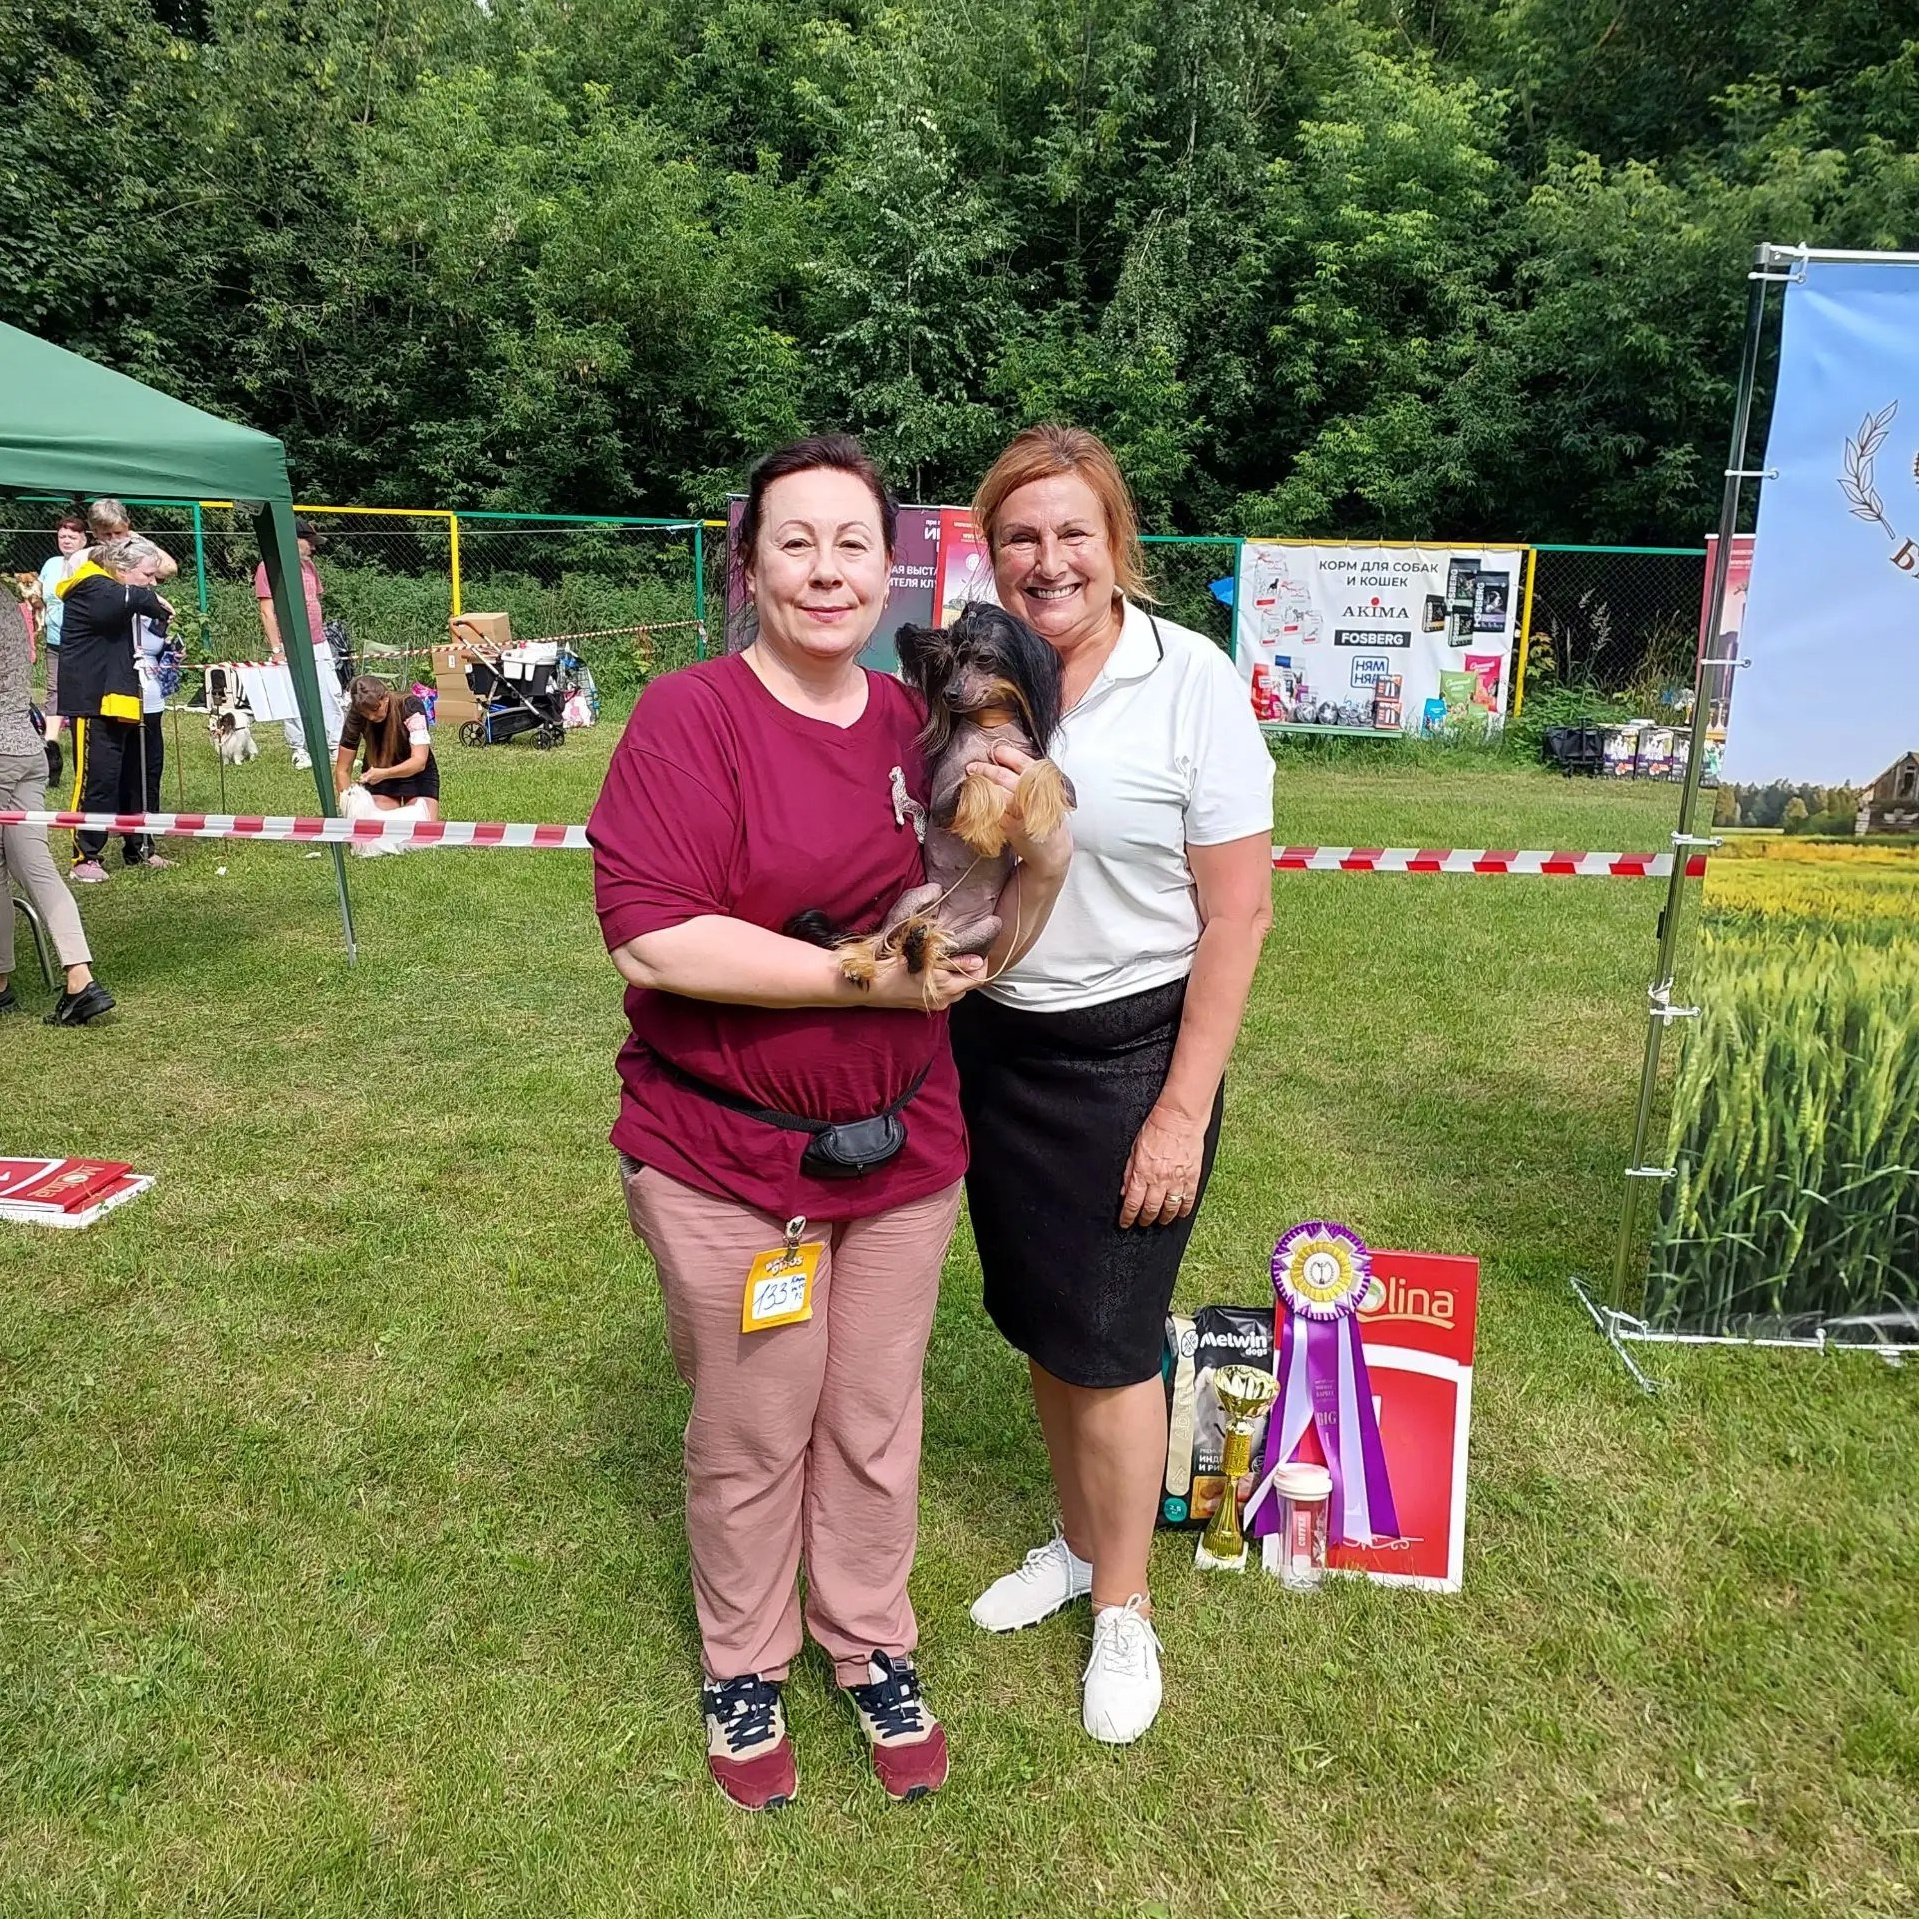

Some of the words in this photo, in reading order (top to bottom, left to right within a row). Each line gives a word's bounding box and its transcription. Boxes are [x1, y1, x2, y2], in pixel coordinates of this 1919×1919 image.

[1319, 560, 1357, 571] КОРМ
[1360, 561, 1389, 573] ДЛЯ
[1393, 562, 1439, 573] СОБАК
[920, 578, 936, 588] КЛ
[1346, 576, 1356, 586] И
[1360, 577, 1408, 587] КОШЕК
[1342, 597, 1410, 619] AKIMA
[1341, 632, 1404, 645] FOSBERG
[1355, 660, 1385, 672] НЯМ
[1200, 1331, 1268, 1349] Melwin
[1245, 1348, 1268, 1358] dogs
[1316, 1410, 1337, 1426] BIG
